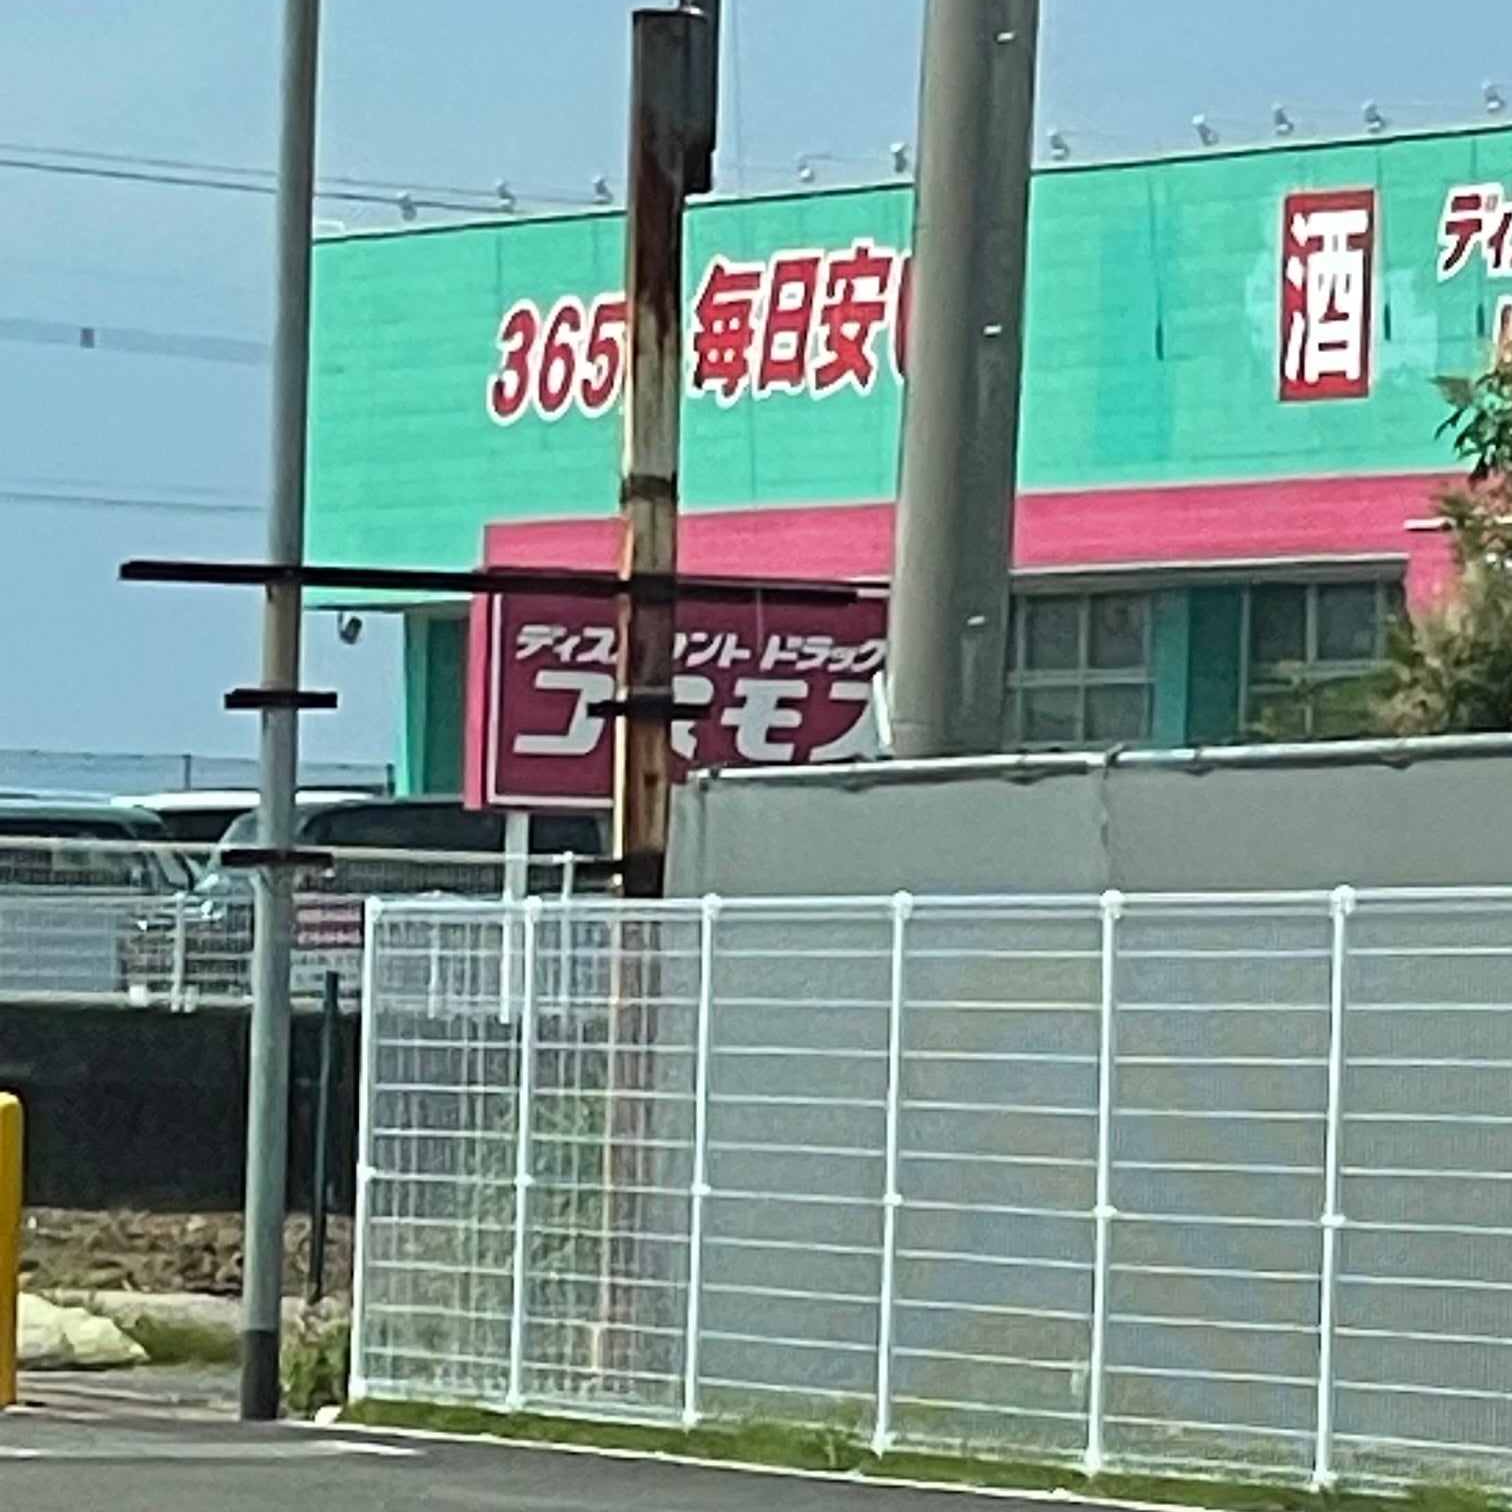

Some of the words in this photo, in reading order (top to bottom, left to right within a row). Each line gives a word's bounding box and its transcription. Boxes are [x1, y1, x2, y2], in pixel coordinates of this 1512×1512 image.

[1281, 208, 1370, 385] 酒
[515, 624, 751, 668] ディスント
